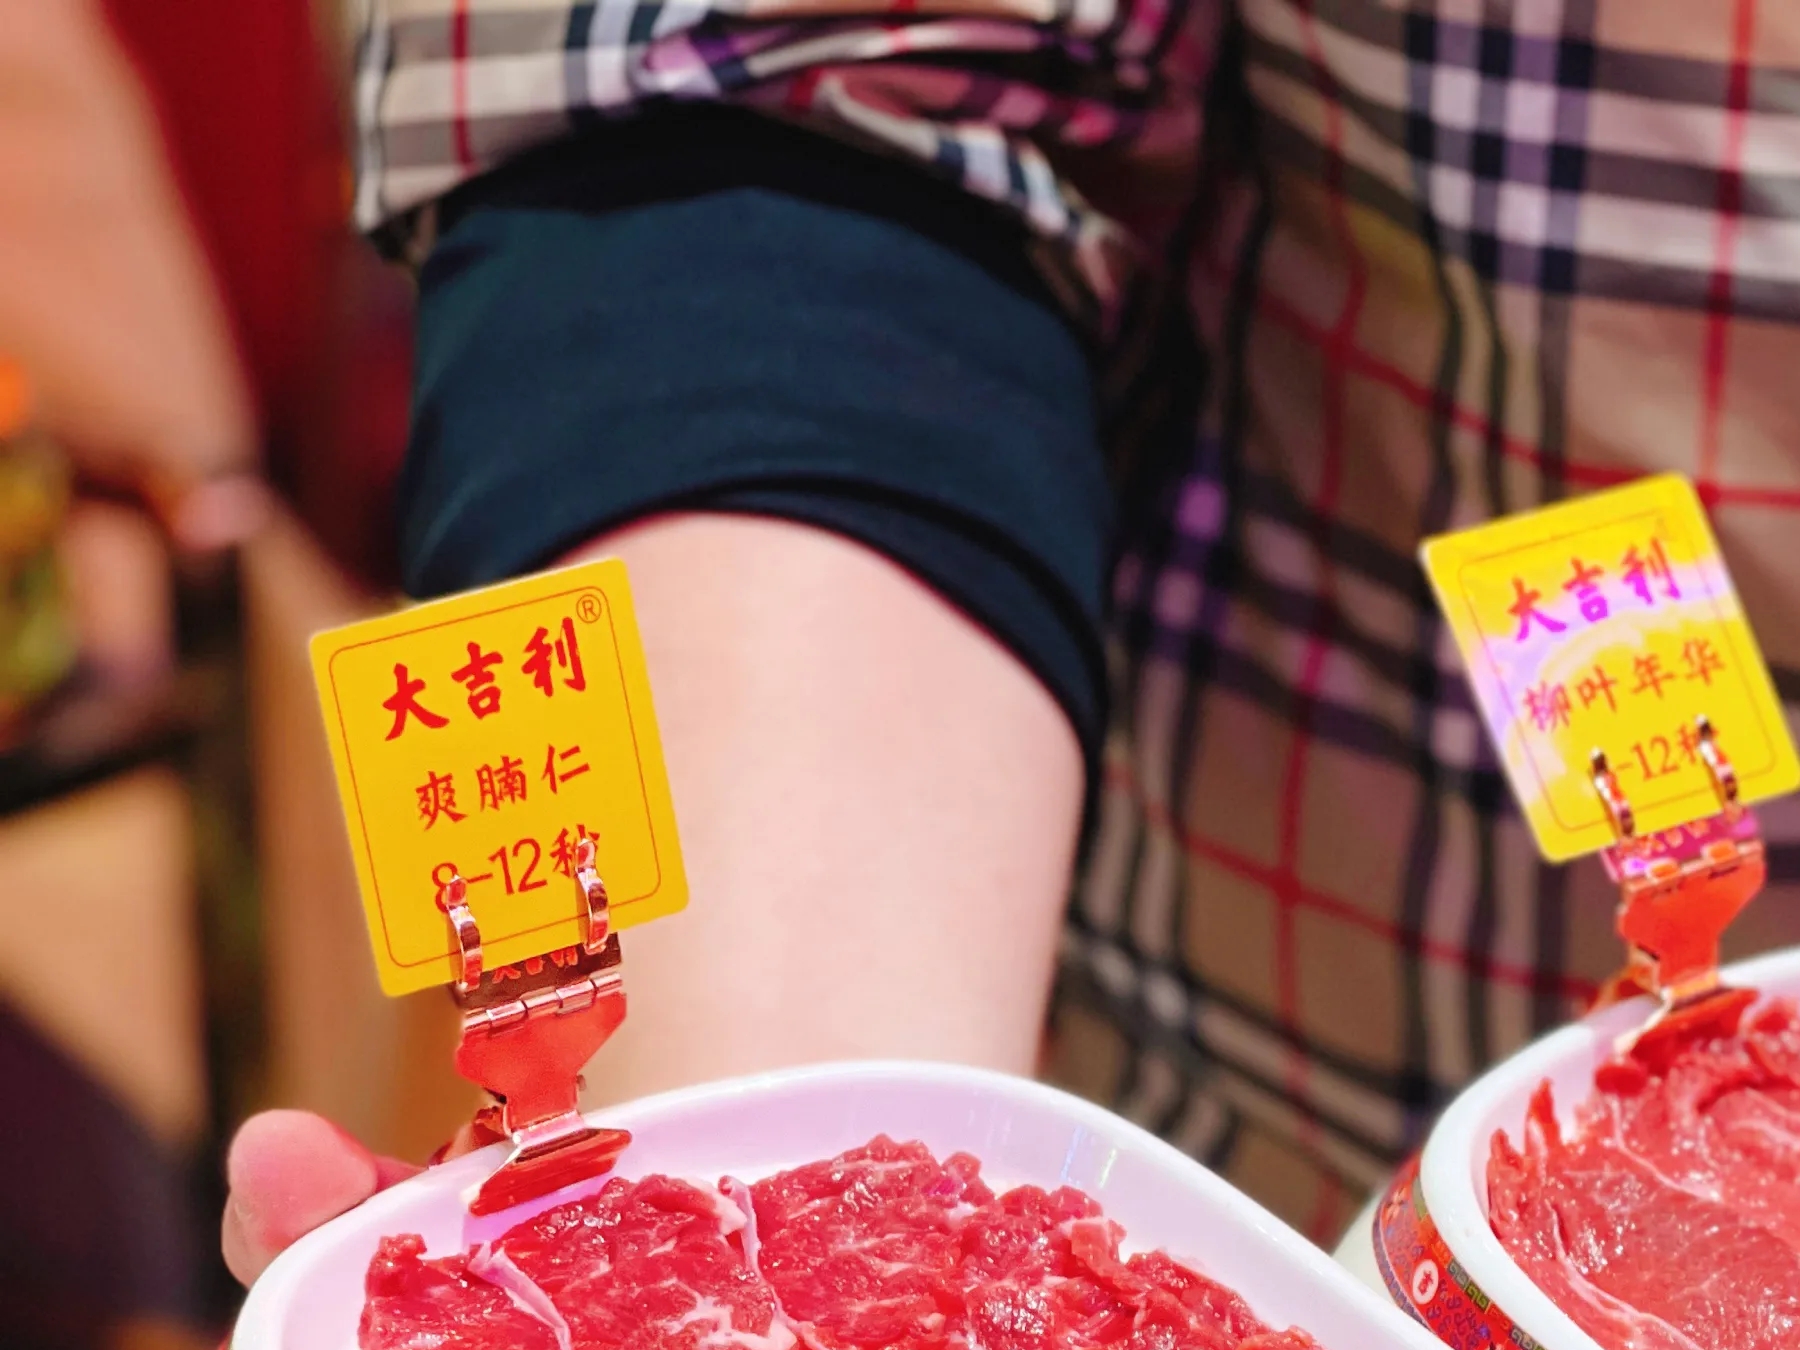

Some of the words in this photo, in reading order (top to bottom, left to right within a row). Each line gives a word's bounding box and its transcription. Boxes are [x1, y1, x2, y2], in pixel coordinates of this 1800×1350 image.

[1506, 537, 1681, 642] 大吉利
[382, 616, 587, 742] 大吉利
[1524, 639, 1726, 732] 柳叶年华
[415, 743, 591, 831] 爽腩仁
[1596, 723, 1718, 783] -12
